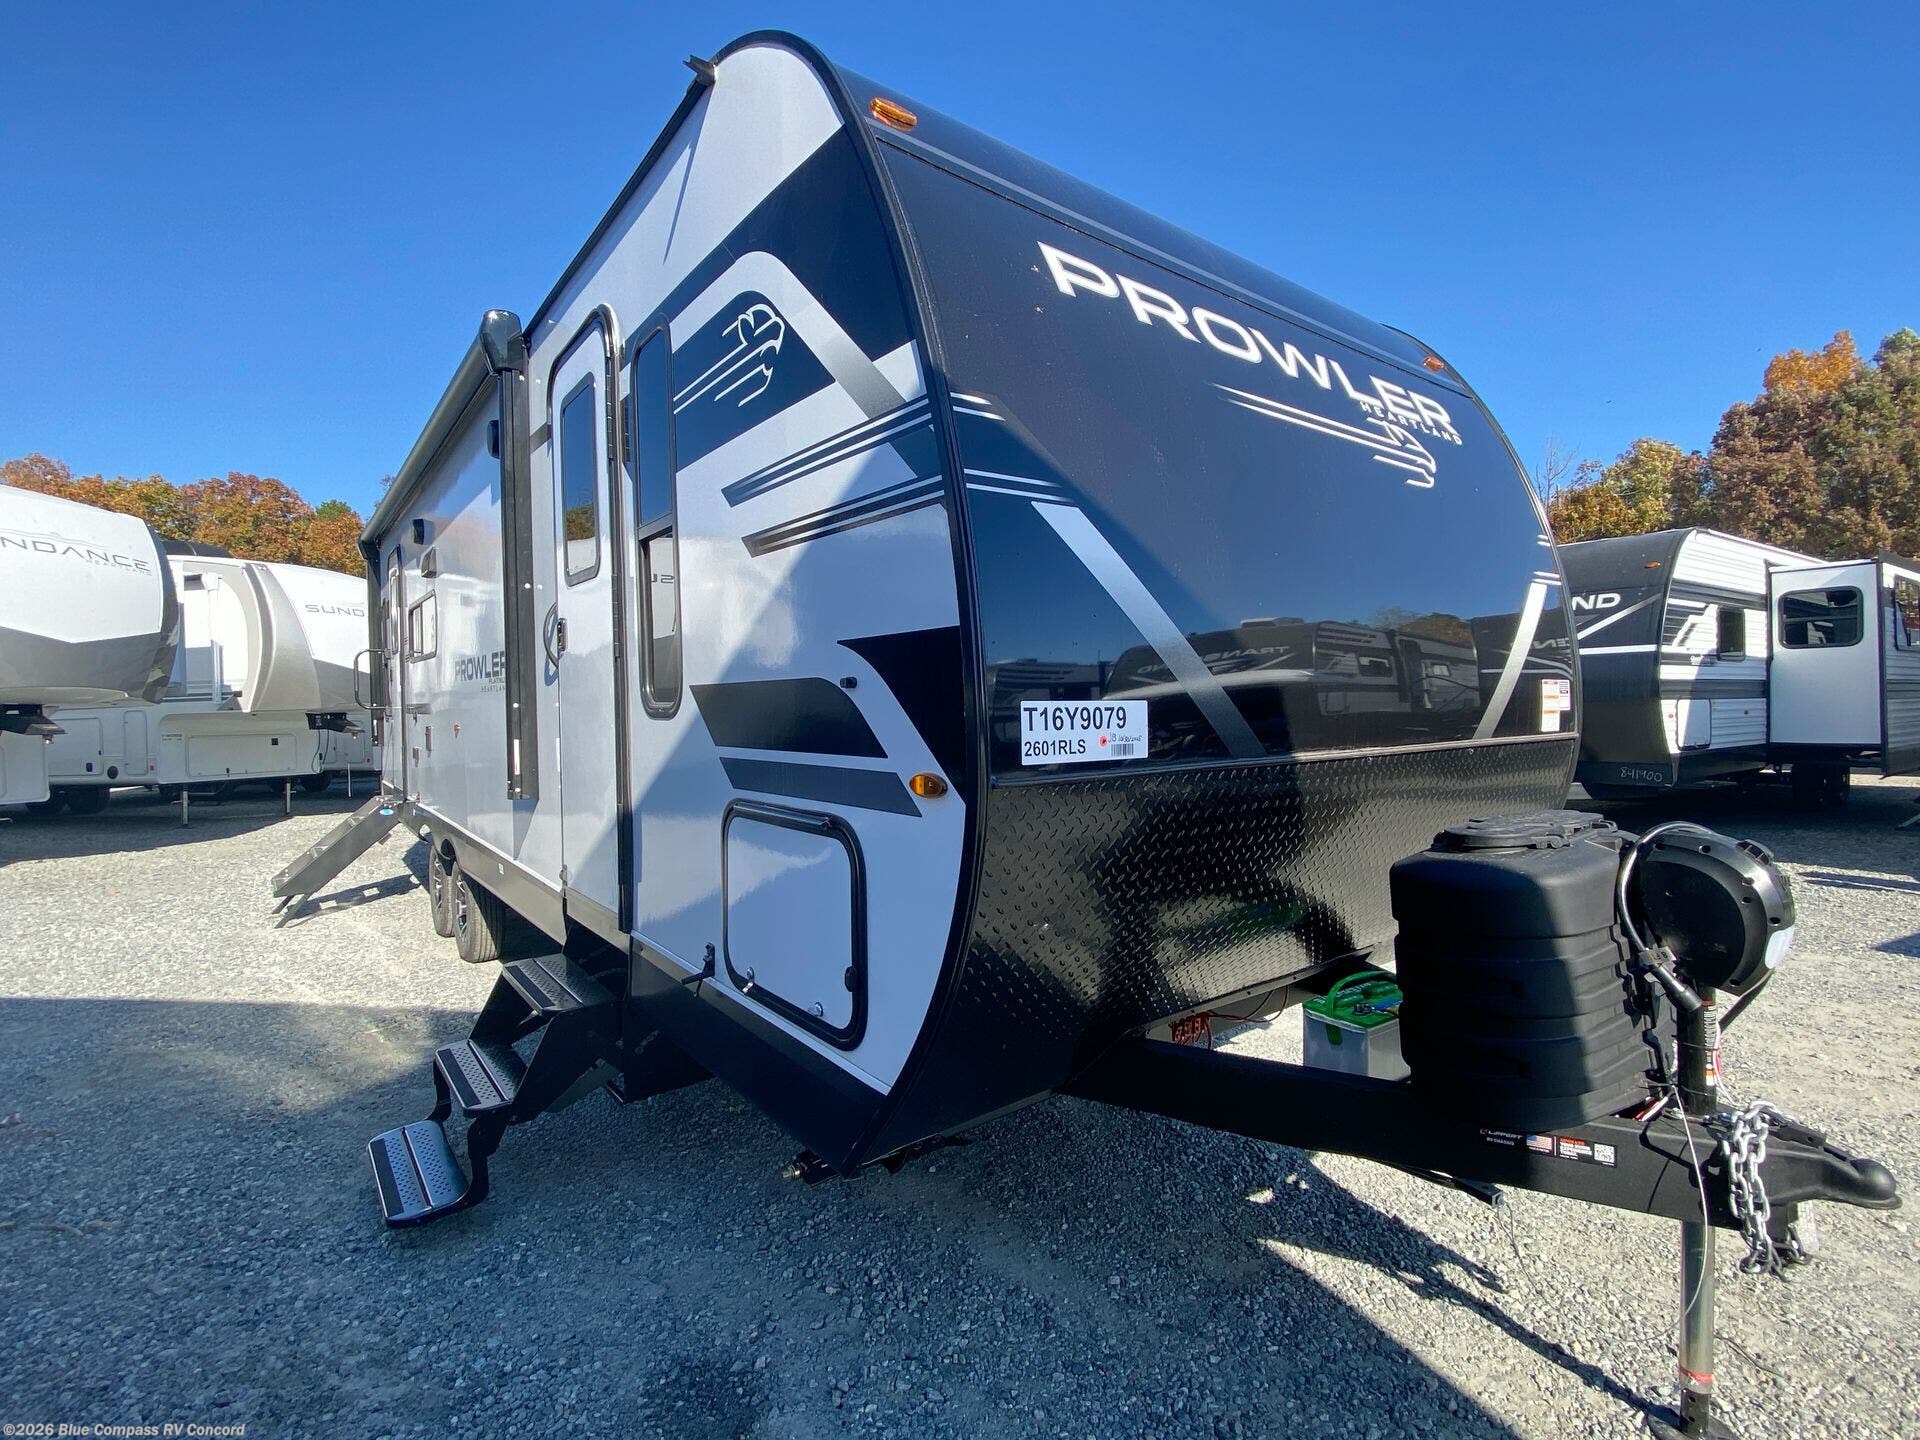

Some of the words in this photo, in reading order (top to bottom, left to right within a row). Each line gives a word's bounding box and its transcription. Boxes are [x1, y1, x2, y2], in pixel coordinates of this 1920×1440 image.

[1037, 241, 1462, 438] PROWLER
[1360, 401, 1463, 446] HEARTLAND
[1023, 706, 1127, 732] T16Y9079
[1024, 739, 1086, 756] 2601RLS
